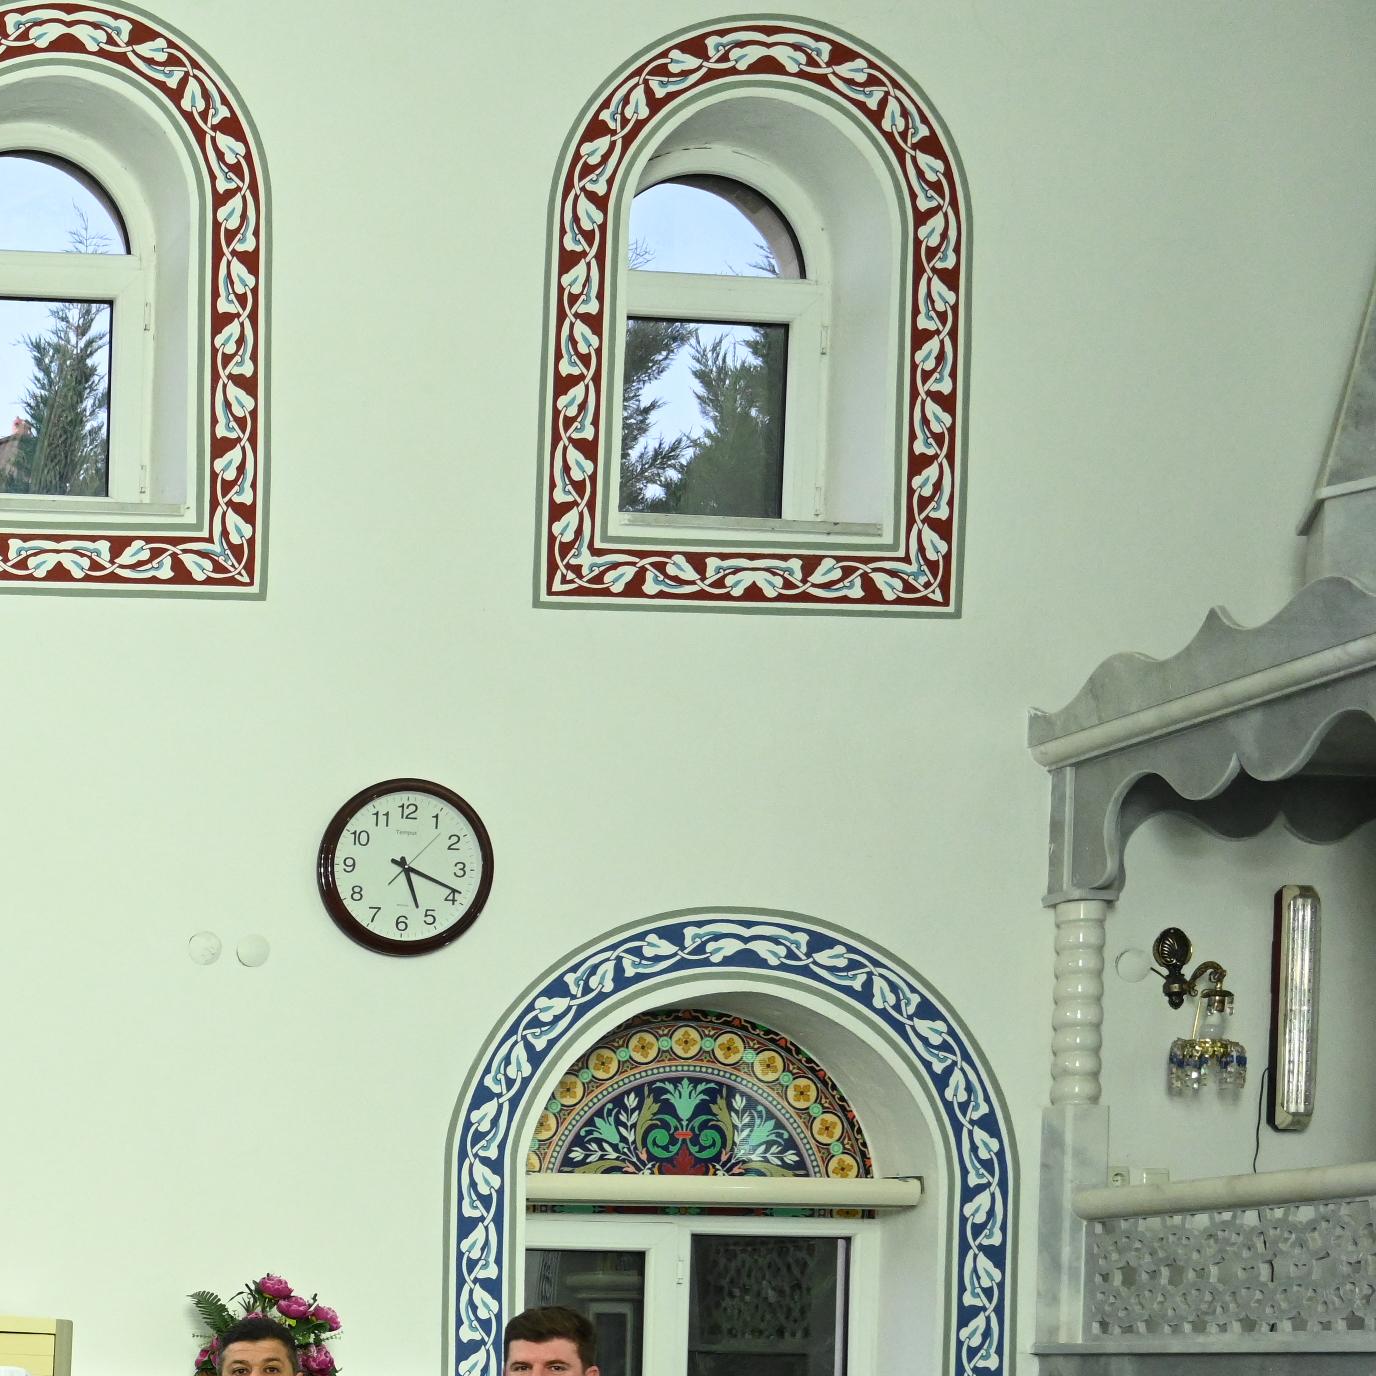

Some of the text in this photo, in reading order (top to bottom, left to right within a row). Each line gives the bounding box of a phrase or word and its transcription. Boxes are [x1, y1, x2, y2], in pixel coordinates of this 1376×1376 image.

[372, 811, 390, 827] 11
[398, 803, 418, 820] 12
[432, 813, 439, 829] 1
[350, 830, 369, 846] 10
[448, 834, 461, 850] 2
[343, 857, 356, 873] 9
[453, 862, 466, 878] 3
[351, 886, 363, 901] 8
[444, 890, 458, 905] 4
[369, 907, 381, 923] 7
[396, 915, 408, 931] 6
[424, 909, 436, 925] 5
